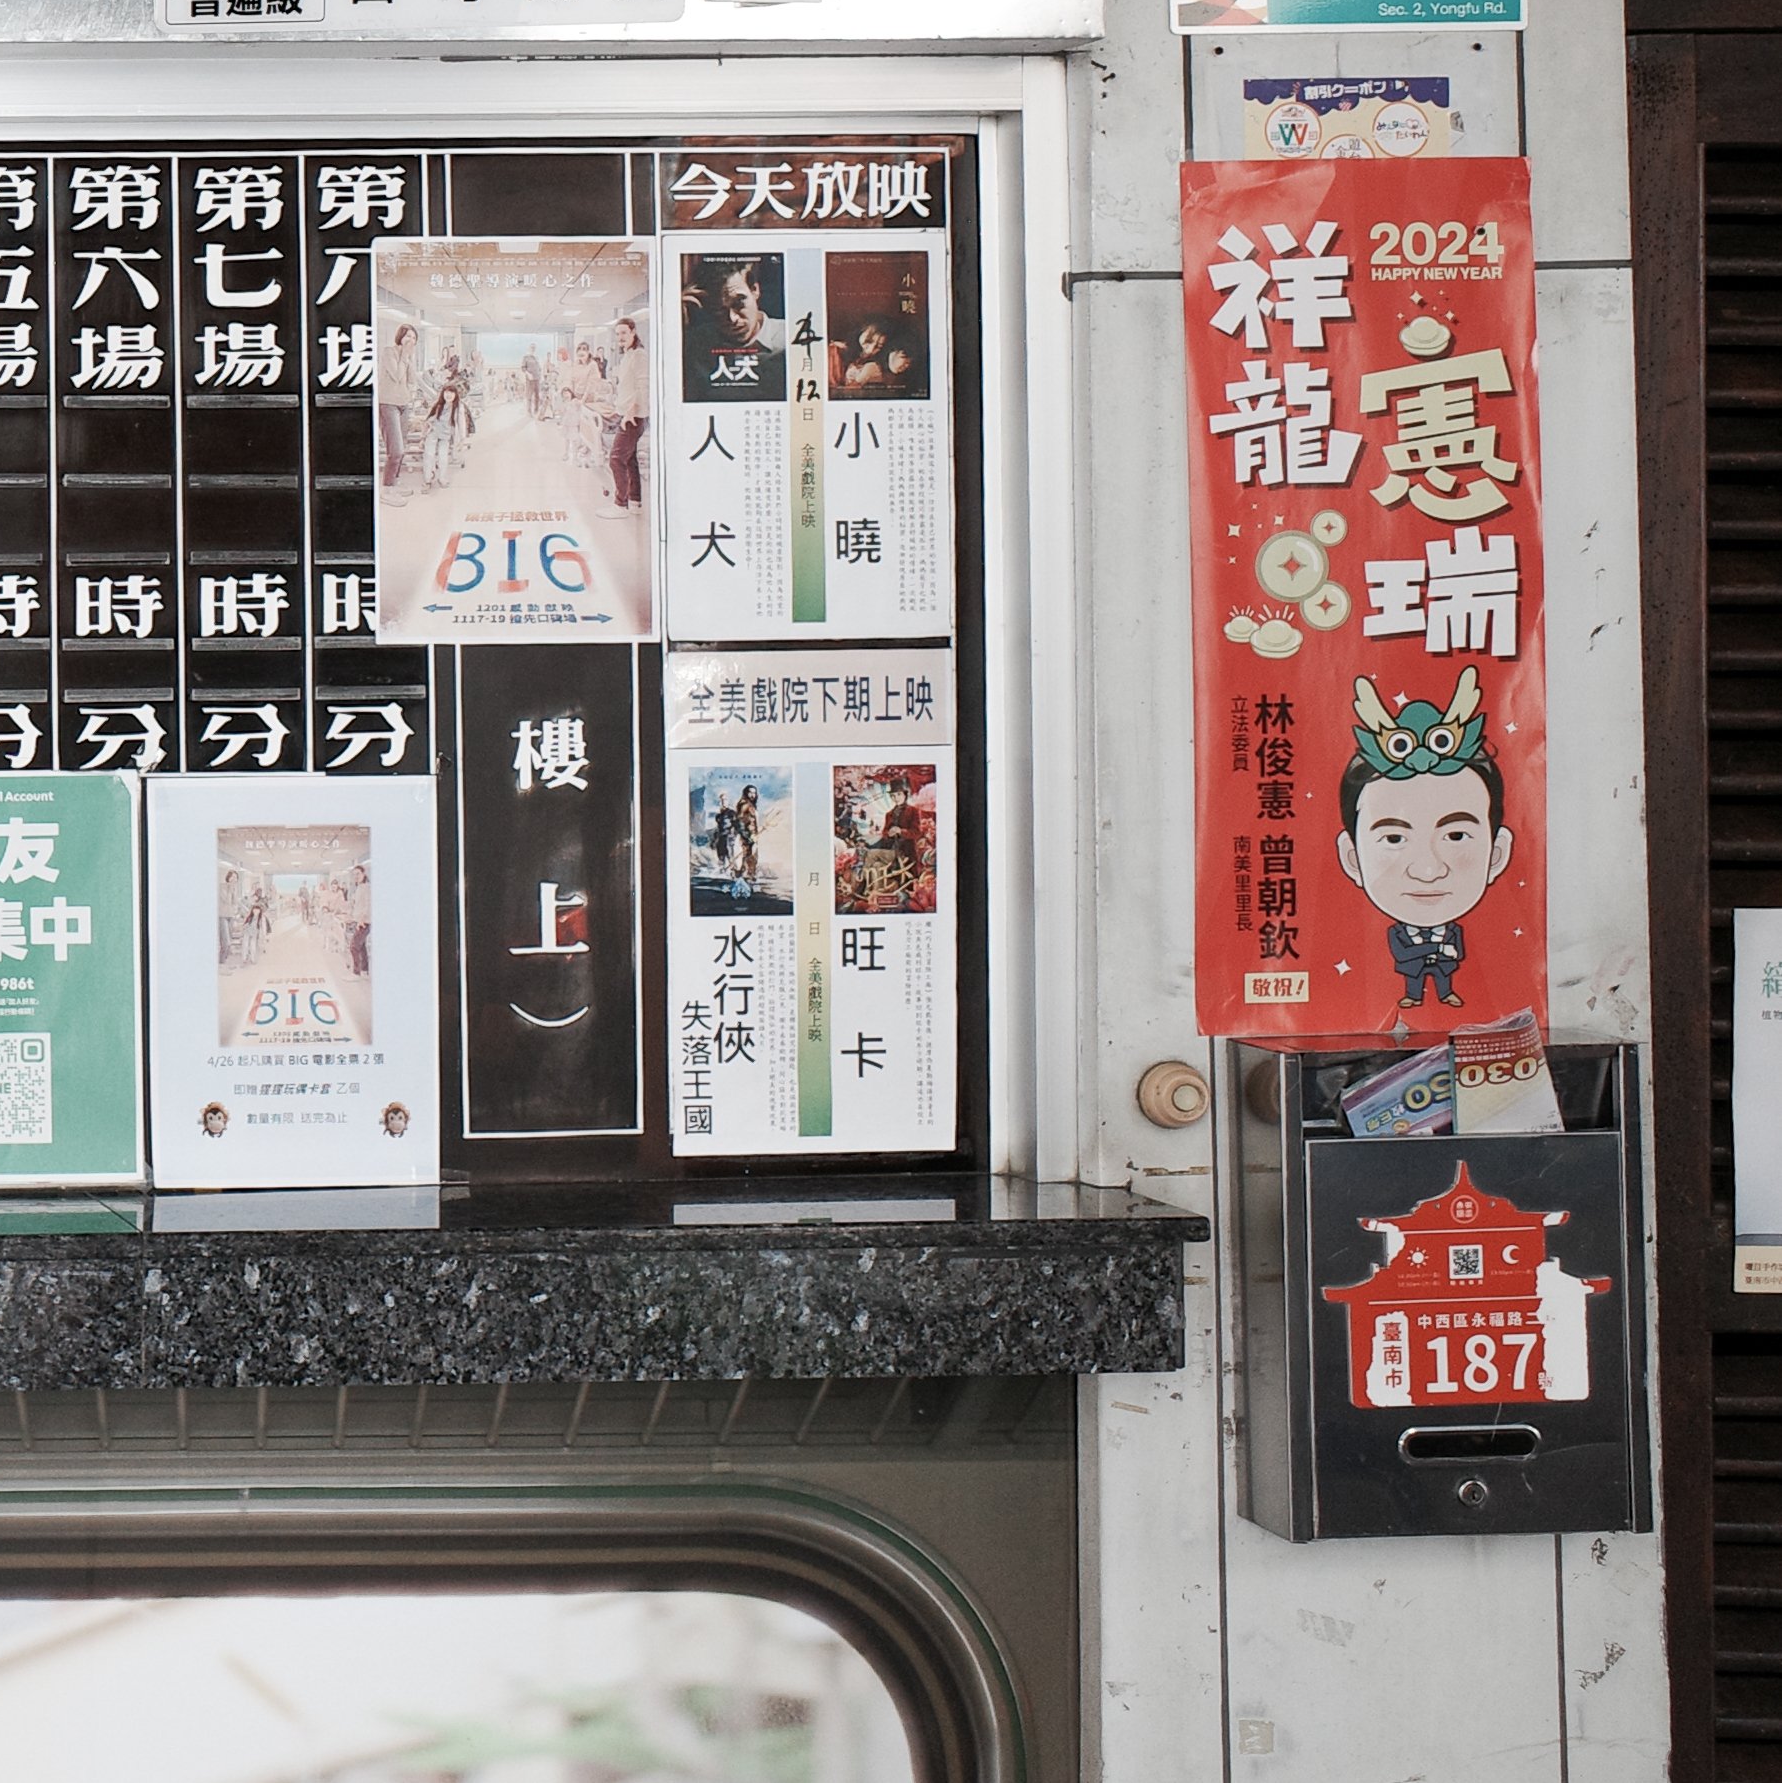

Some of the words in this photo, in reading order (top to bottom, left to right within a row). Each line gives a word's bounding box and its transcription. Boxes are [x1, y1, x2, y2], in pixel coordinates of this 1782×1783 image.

[1378, 2, 1408, 17] Sec.
[1429, 2, 1481, 20] Yongfu
[1484, 1, 1507, 15] Rd.
[669, 161, 933, 221] 今天放映
[69, 164, 164, 390] 第六場
[193, 165, 287, 389] 第七場
[429, 272, 595, 289] 魏德聖導演暖心之作
[1368, 221, 1504, 266] 2024
[1371, 266, 1423, 282] HAPPY
[1425, 266, 1457, 281] NEW
[1459, 265, 1504, 281] YEAR
[1206, 219, 1365, 489] 祥龍
[688, 414, 736, 569] 人犬
[800, 442, 817, 530] 全美戲院上映
[835, 411, 883, 565] 小曉
[1359, 346, 1523, 659] 憲瑞
[435, 529, 594, 594] BIG
[687, 674, 934, 725] 全美戲院下期上映
[1231, 695, 1250, 773] 立法委員
[4, 791, 54, 802] Account
[1254, 693, 1299, 822] 林俊憲
[1231, 835, 1253, 933] 南美里里長
[1255, 833, 1301, 963] 曾朝欽
[712, 924, 757, 1065] 水行俠
[807, 957, 823, 1043] 全美戲院上映
[840, 926, 888, 1078] 旺卡
[1251, 977, 1305, 1000] 敬祝!
[207, 1056, 233, 1067] 4/26
[238, 1055, 286, 1066] 起凡購買
[289, 1055, 309, 1066] BIG
[312, 1054, 359, 1066] 電影全票
[681, 999, 713, 1136] 失落王國
[247, 1112, 294, 1124] 數量有限
[1383, 1321, 1403, 1389] 臺南市
[1426, 1333, 1537, 1393] 187
